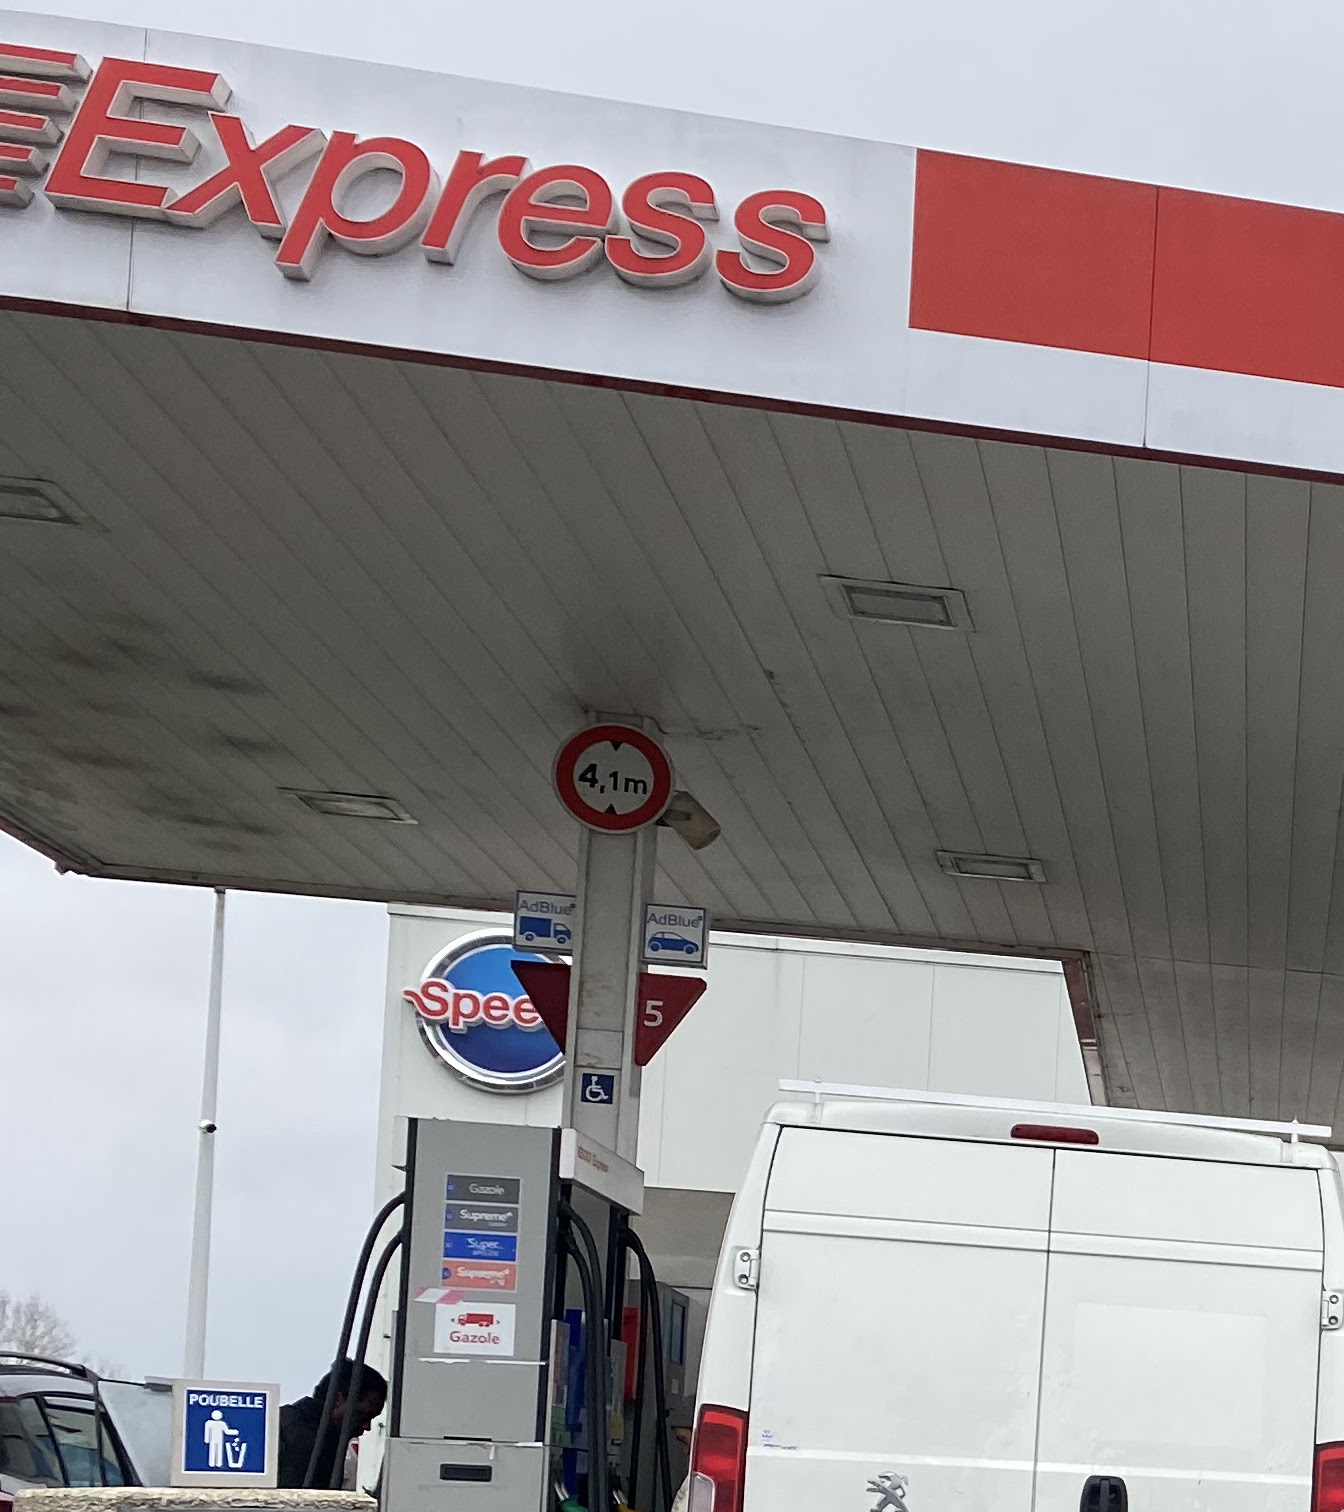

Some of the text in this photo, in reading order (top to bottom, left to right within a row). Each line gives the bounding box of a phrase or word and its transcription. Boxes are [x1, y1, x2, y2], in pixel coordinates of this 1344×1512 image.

[44, 55, 830, 304] Express
[578, 763, 648, 795] 4,1m
[403, 979, 541, 1031] Spee
[643, 1000, 664, 1027] 5
[449, 1330, 501, 1345] Gazole
[188, 1392, 264, 1410] POUBELLE
